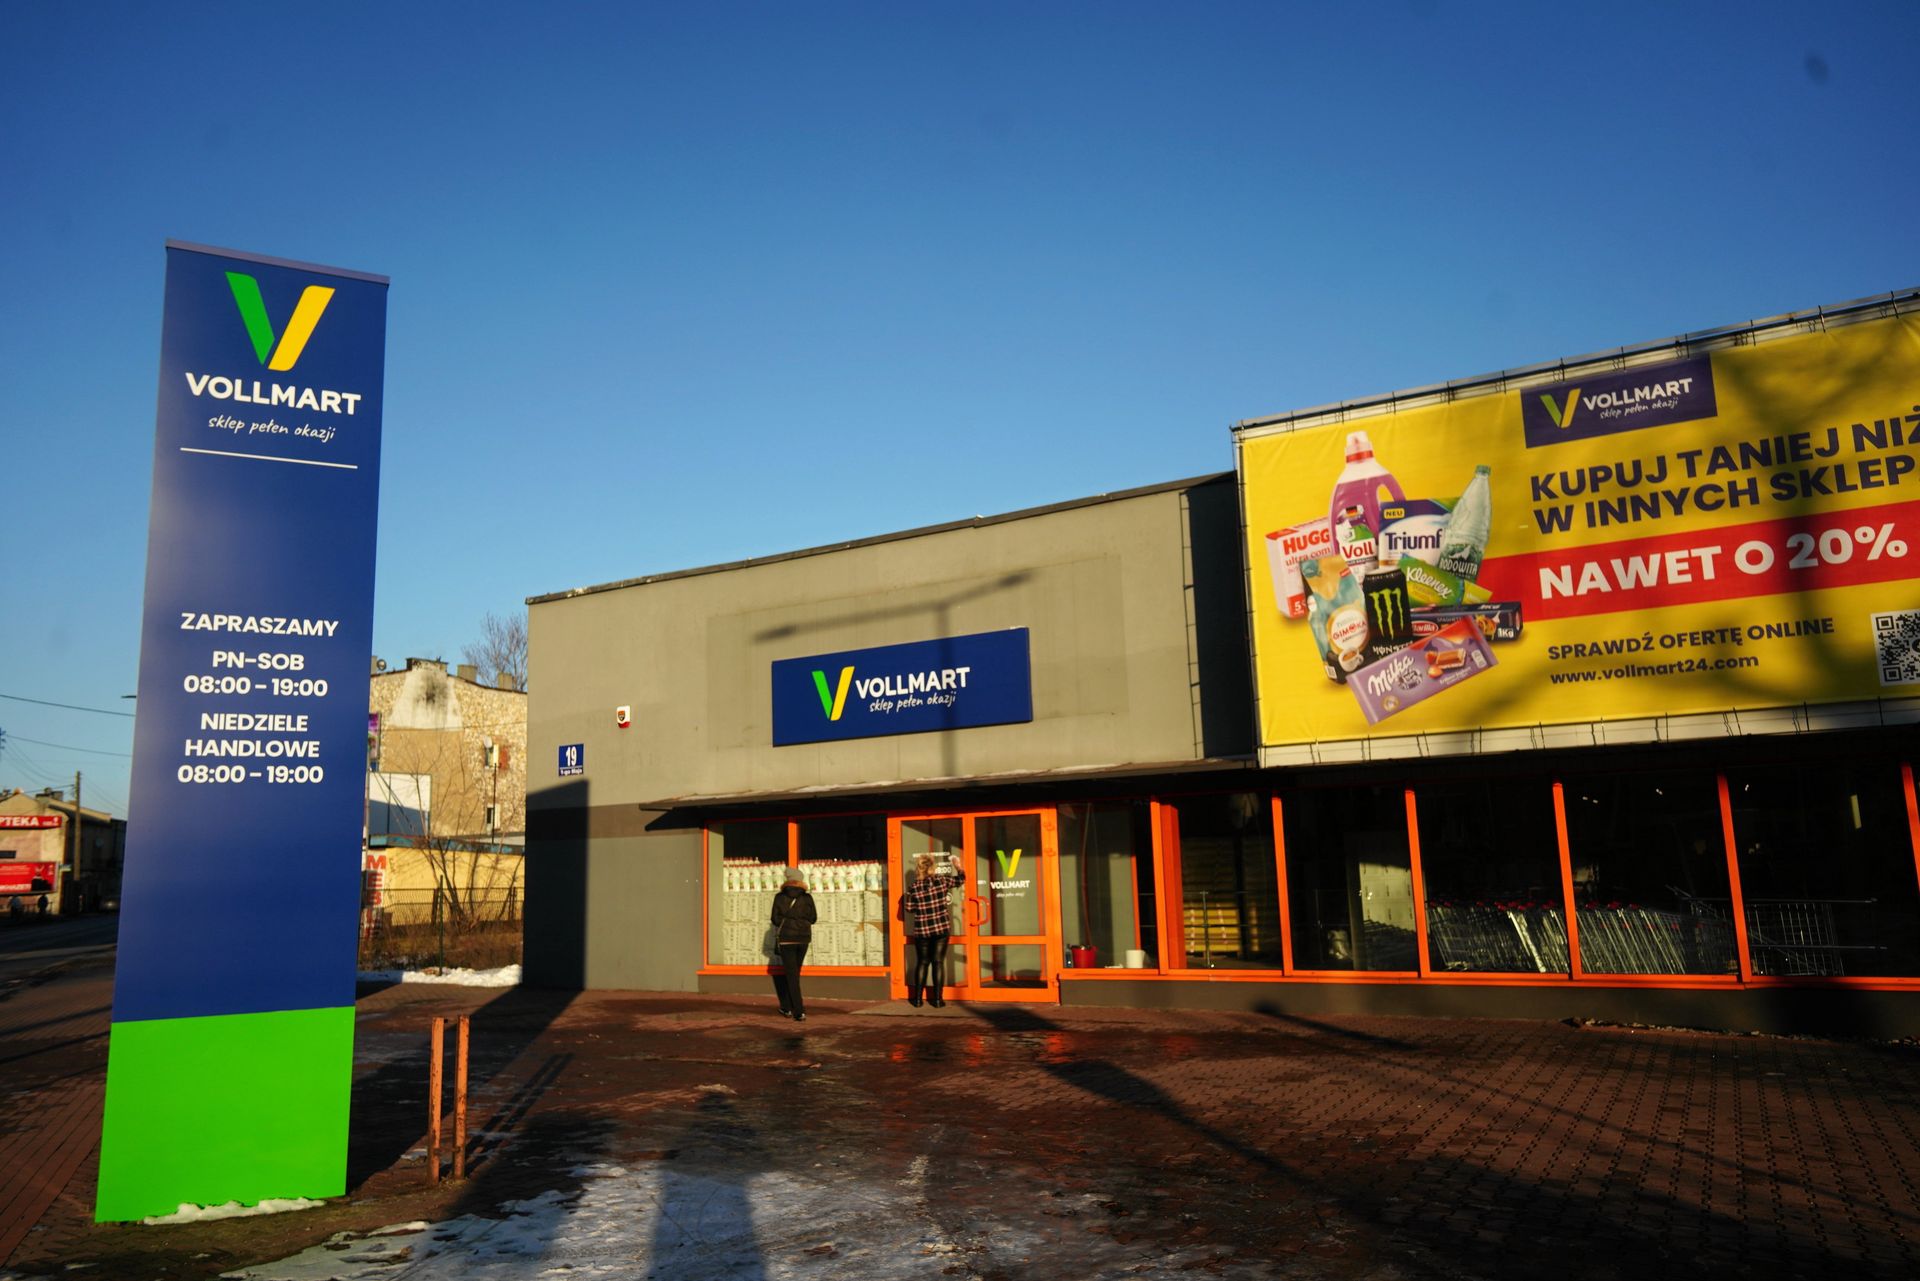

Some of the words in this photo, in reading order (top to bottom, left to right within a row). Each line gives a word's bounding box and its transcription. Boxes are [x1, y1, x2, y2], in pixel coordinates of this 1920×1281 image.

[185, 372, 361, 415] VOLLMART
[1583, 378, 1692, 411] VOLLMART
[1600, 407, 1622, 419] sklep
[208, 415, 245, 434] sklep
[249, 419, 289, 434] pełen
[294, 424, 336, 443] okazji
[1531, 455, 1667, 501] KUPUJ
[1677, 428, 1839, 478] TANIEJ
[1852, 405, 1920, 452] NIŻ
[1386, 509, 1402, 517] NEU
[1534, 505, 1574, 535] W
[1586, 476, 1760, 529] INNYCH
[1283, 528, 1330, 556] HUGG
[1342, 541, 1373, 559] Voll
[1385, 528, 1443, 550] Triumf
[1539, 545, 1722, 600] NAWET
[1734, 540, 1775, 575] O
[1786, 523, 1908, 569] 20%
[1406, 566, 1452, 599] Kleenex
[181, 612, 339, 637] ZAPRASZAMY
[1498, 628, 1514, 639] 1Kg
[1548, 632, 1655, 660] SPRAWDŹ
[1660, 627, 1743, 649] OFERTĘ
[1747, 618, 1835, 640] ONLINE
[1368, 655, 1414, 697] Milka
[1550, 654, 1759, 684] www.vollmart24.com
[183, 675, 251, 694] 08:00
[271, 678, 328, 697] 19:00
[855, 667, 970, 699] VOLLMART
[869, 698, 894, 714] sklep
[896, 694, 924, 712] pełen
[927, 691, 957, 707] okazji
[201, 713, 308, 731] NIEDZIELE
[185, 739, 320, 757] HANDLOWE
[566, 746, 577, 767] 19
[177, 765, 246, 783] 08:00
[266, 765, 324, 783] 19:00
[990, 880, 1030, 889] VOLLMART
